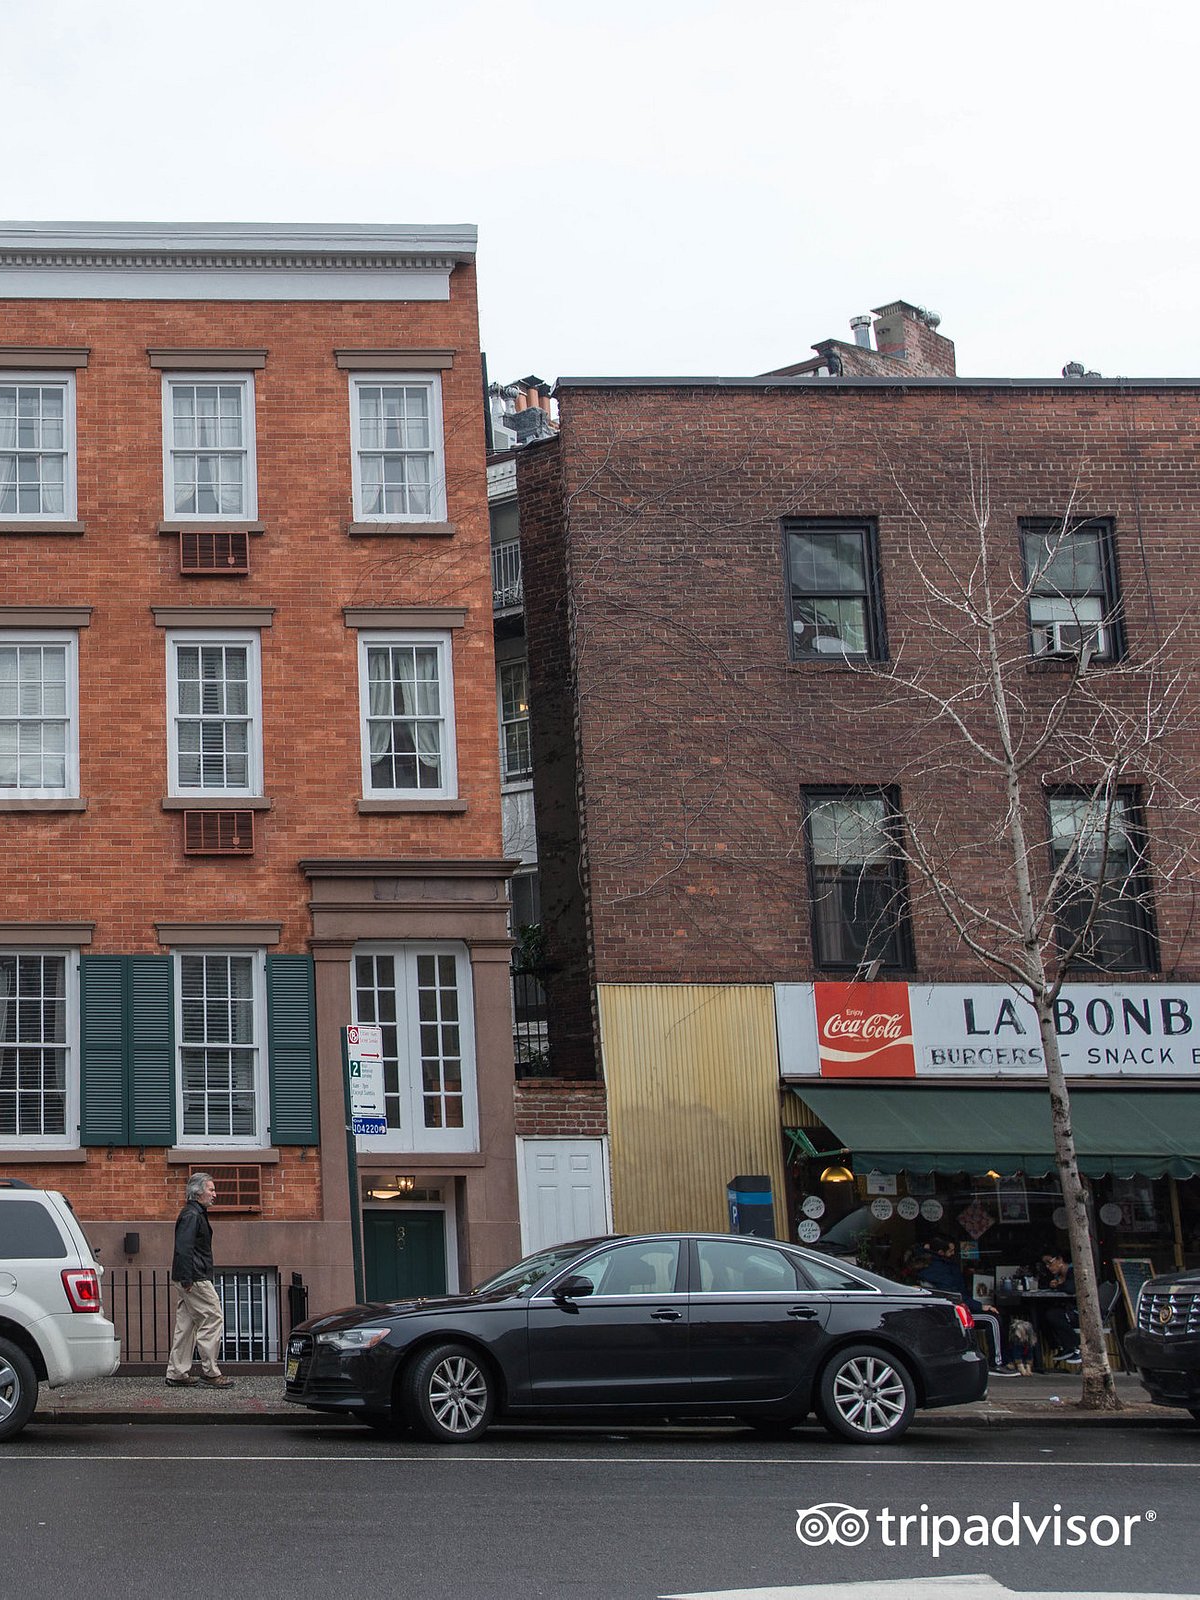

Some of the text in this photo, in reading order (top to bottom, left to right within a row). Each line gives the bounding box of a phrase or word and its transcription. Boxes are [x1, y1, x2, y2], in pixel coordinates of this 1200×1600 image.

[846, 1009, 864, 1017] Enjoy
[963, 998, 1027, 1035] LA
[823, 1013, 905, 1039] Coca-Cola
[931, 1048, 1043, 1065] BURGERS
[1088, 1047, 1175, 1065] SNACK
[352, 1061, 360, 1077] 2
